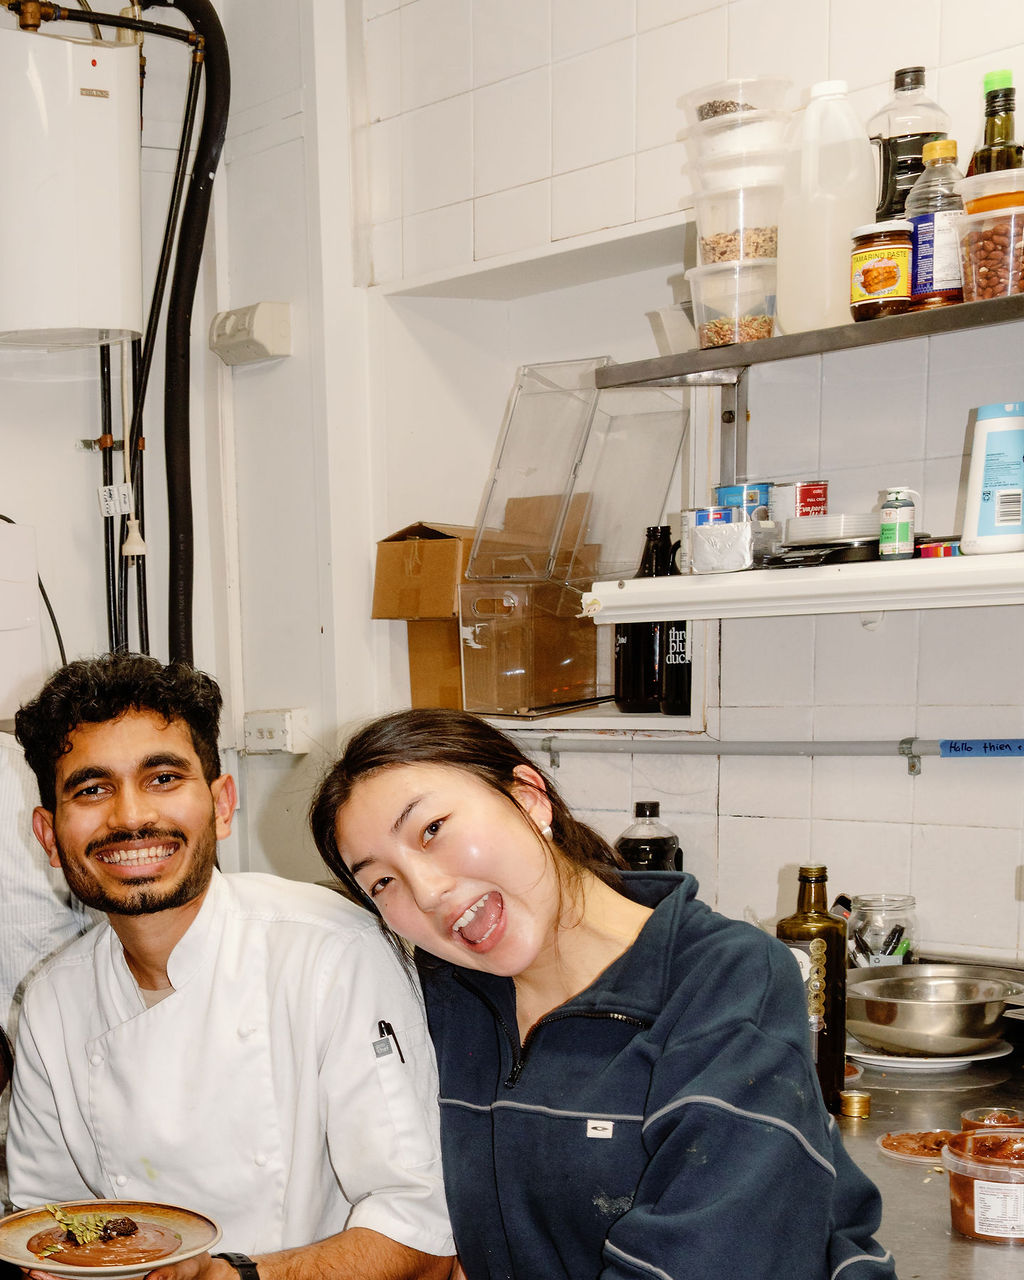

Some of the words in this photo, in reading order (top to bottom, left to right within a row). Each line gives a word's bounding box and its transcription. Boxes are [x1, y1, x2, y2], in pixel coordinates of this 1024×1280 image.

[887, 251, 907, 259] PASTE
[669, 627, 687, 640] thr
[669, 640, 686, 653] blu
